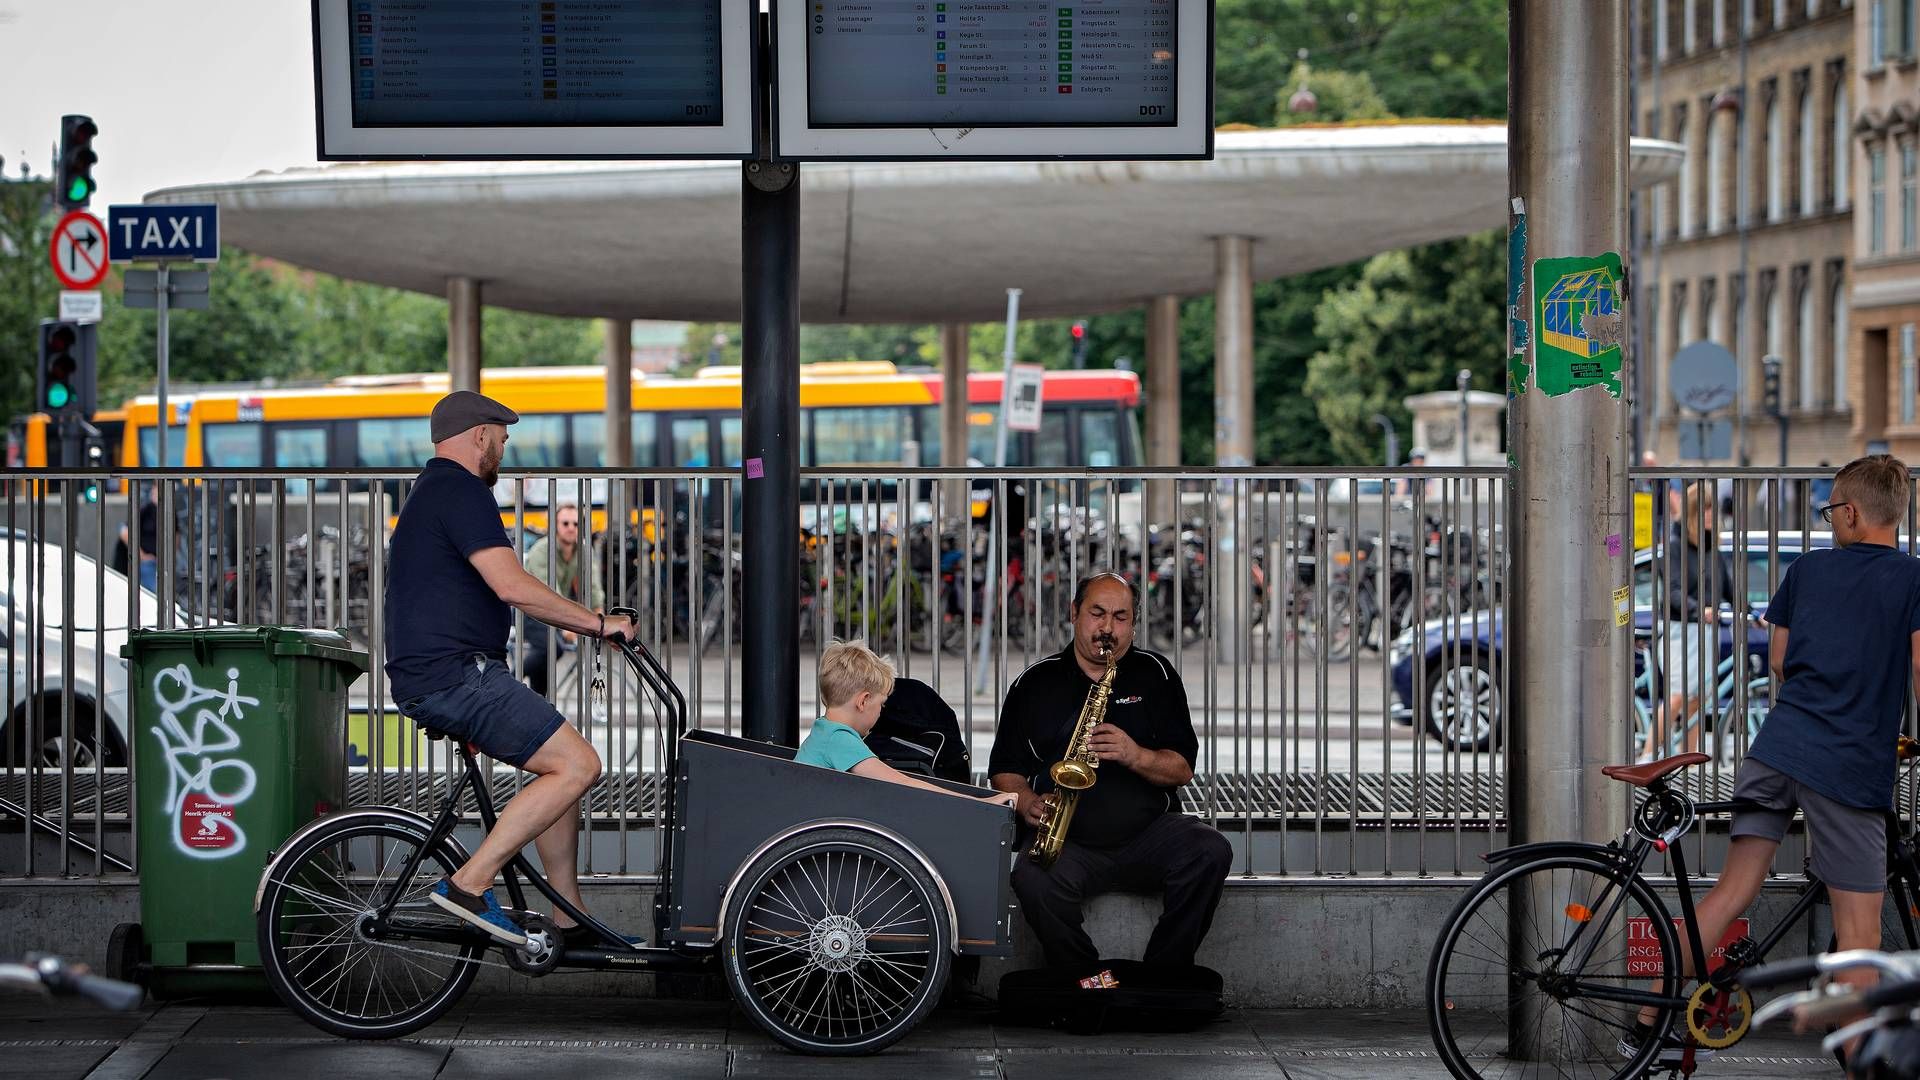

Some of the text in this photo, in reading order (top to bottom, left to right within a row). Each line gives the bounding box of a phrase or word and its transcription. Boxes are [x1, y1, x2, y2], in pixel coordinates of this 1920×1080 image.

[686, 104, 710, 115] DOT
[1140, 105, 1165, 115] DOT
[118, 216, 203, 248] TAXI
